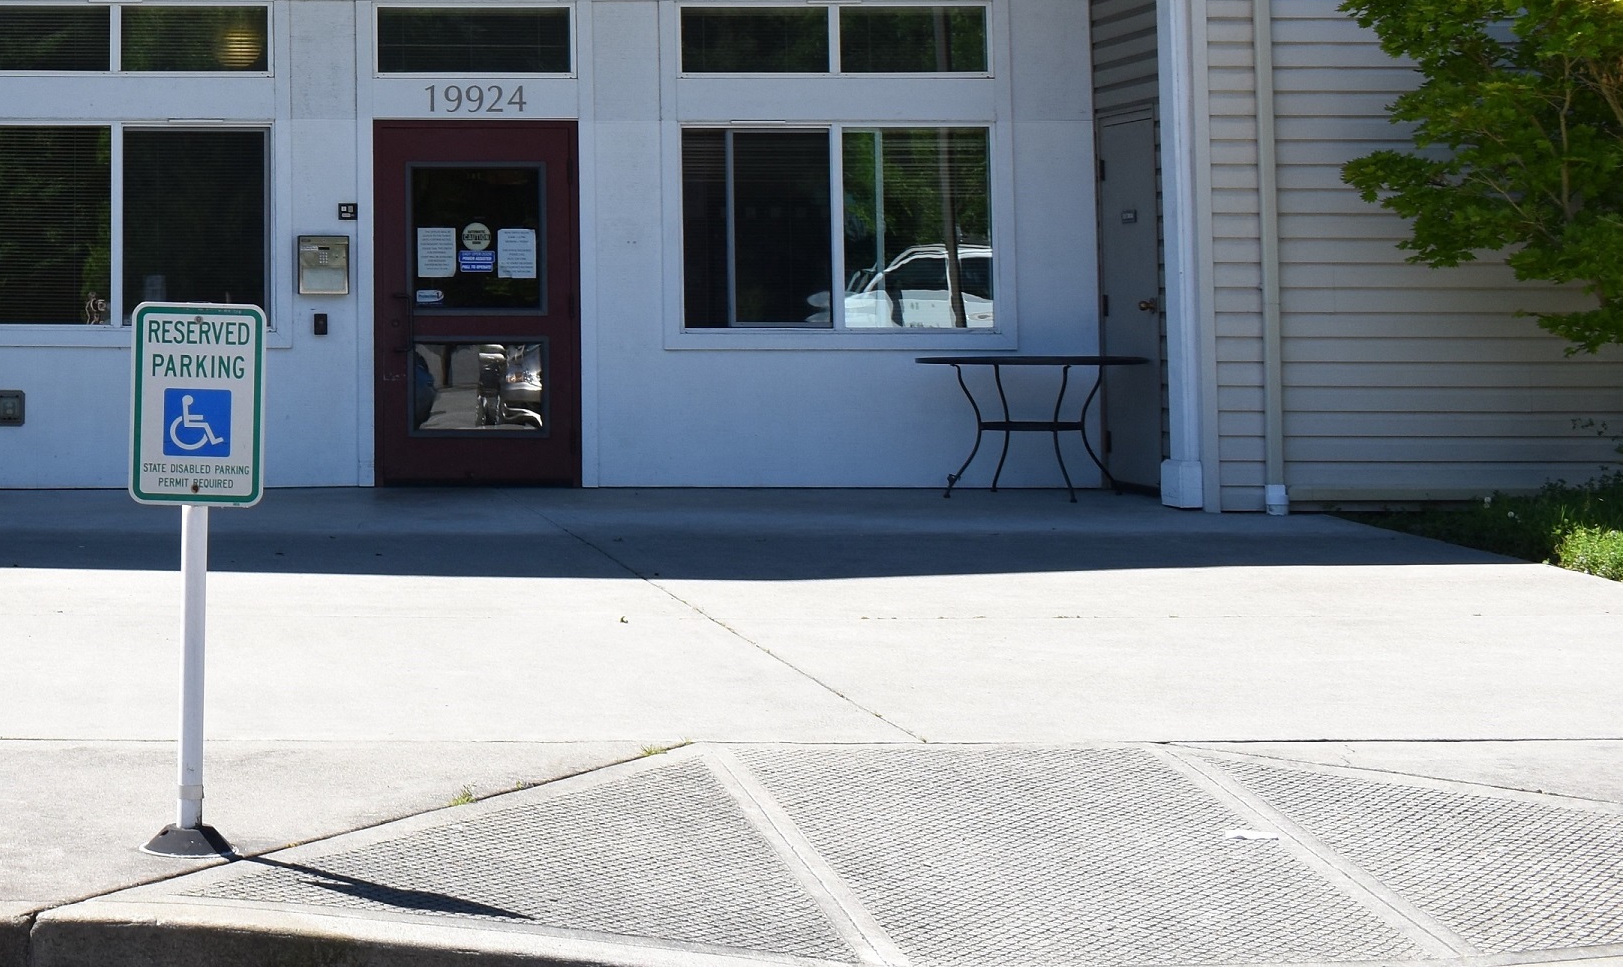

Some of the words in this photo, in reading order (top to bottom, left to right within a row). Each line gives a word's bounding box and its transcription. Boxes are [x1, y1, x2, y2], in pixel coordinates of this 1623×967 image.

[424, 84, 527, 113] 19924
[147, 319, 251, 346] RESERVED
[151, 353, 246, 380] PARKING
[143, 462, 167, 473] STATE
[170, 463, 211, 474] DISABLED
[214, 464, 251, 475] PARKING
[158, 477, 189, 488] PERMIT
